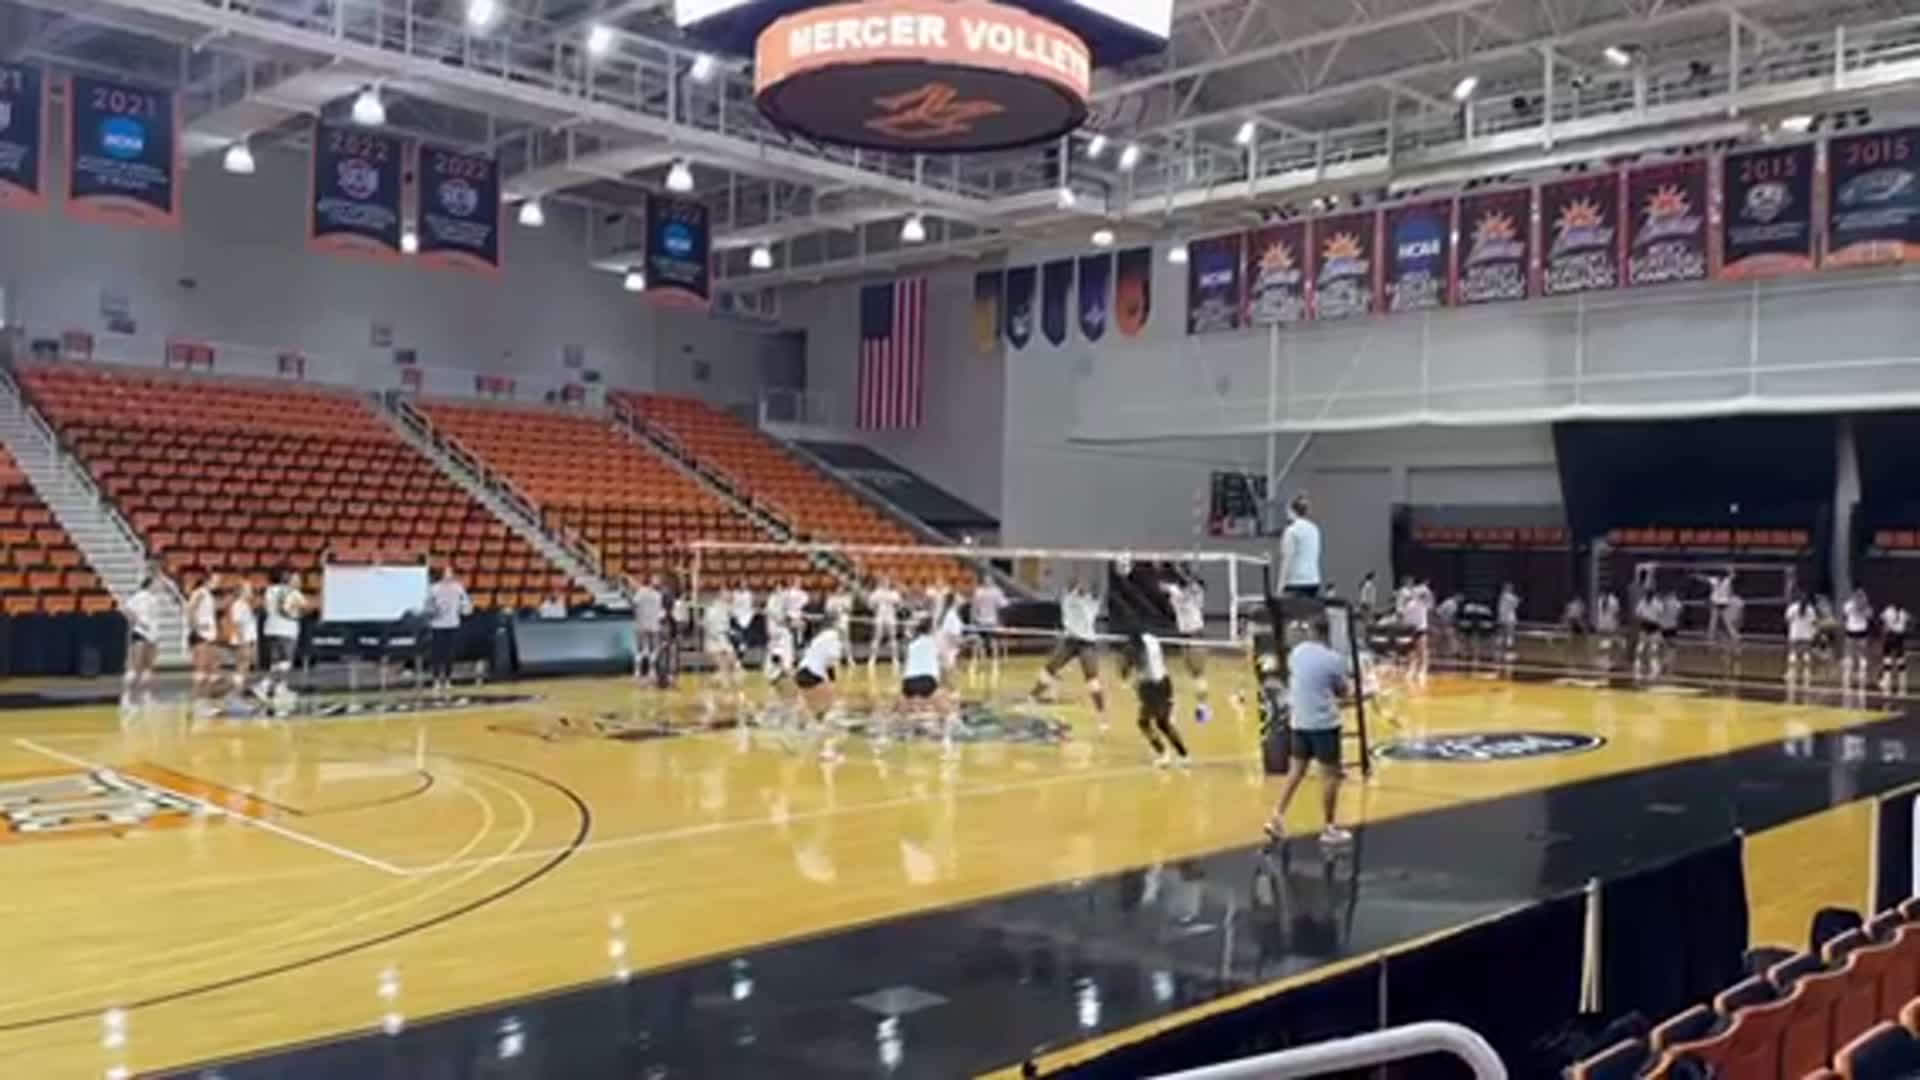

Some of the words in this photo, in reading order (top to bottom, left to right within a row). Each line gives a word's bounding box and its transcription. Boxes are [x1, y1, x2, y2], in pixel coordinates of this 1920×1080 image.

[789, 14, 948, 57] MERCER
[91, 87, 156, 118] 2021
[1844, 136, 1913, 166] 2015
[1740, 155, 1798, 182] 2015
[1397, 239, 1440, 257] NCAA
